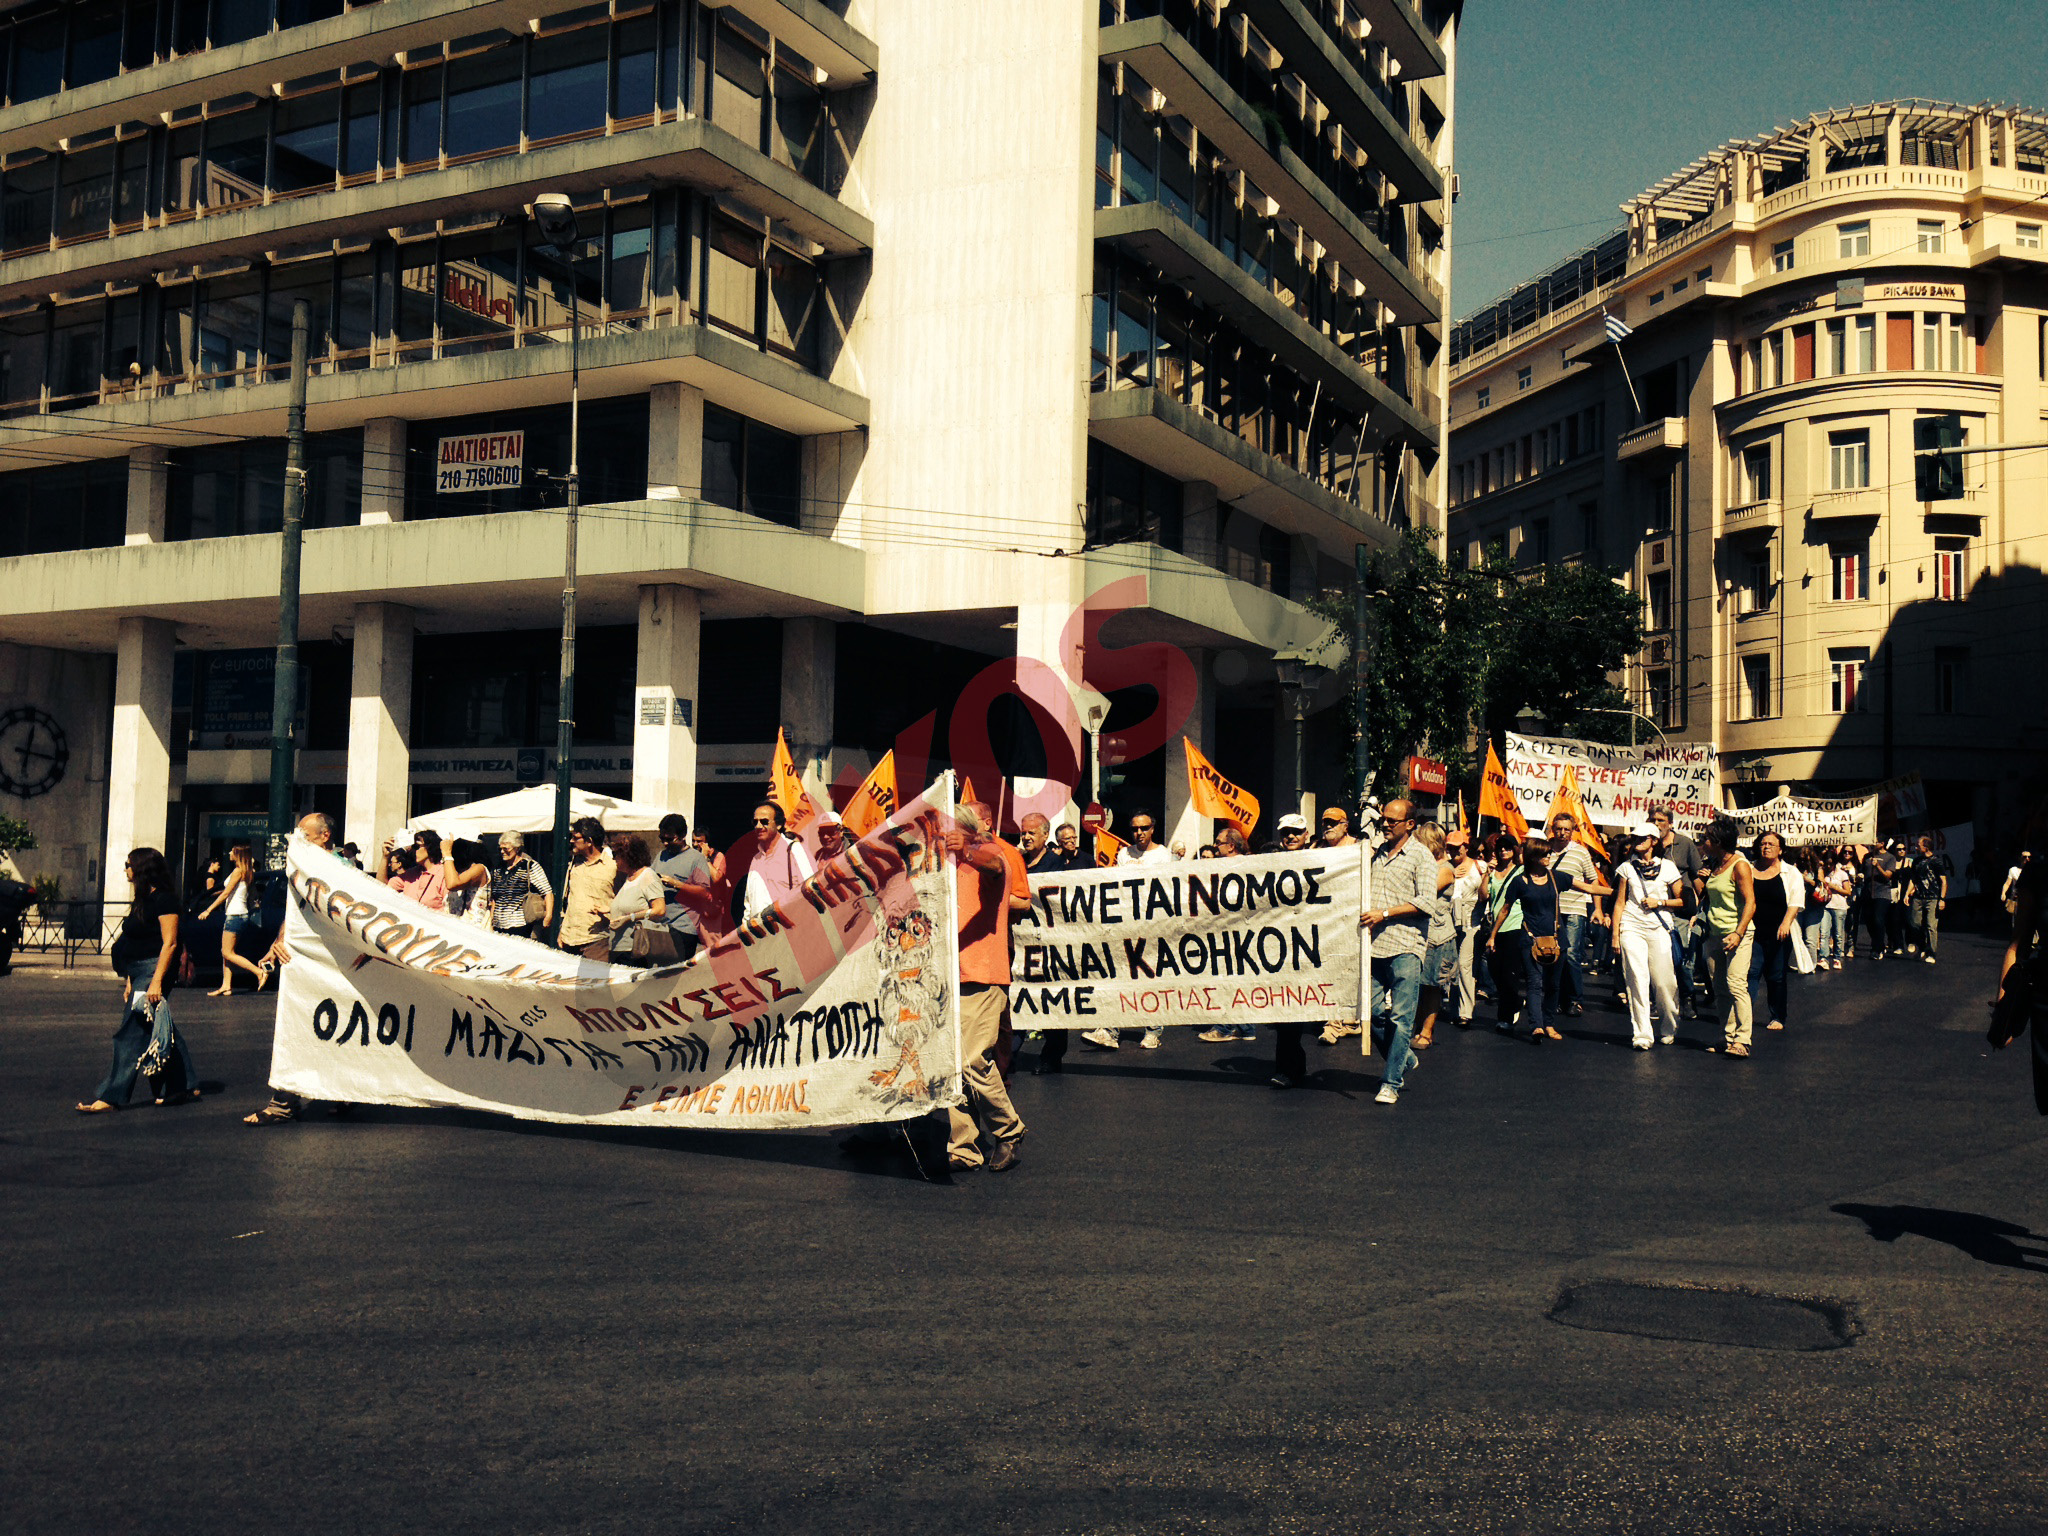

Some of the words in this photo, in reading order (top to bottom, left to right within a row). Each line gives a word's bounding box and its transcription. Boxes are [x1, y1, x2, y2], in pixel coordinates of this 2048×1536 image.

[1930, 286, 1956, 297] BANK
[441, 435, 521, 464] ΔΙΑΤΙΘΕΤΑΙ
[440, 470, 461, 489] 210
[466, 465, 520, 488] 7760600
[225, 654, 276, 672] euroch
[1532, 741, 1579, 758] ΕΙΣΤΕ
[1586, 745, 1636, 764] ΠΑΝΤΑ
[409, 760, 449, 772] ΘΝΙΚΗ
[451, 760, 513, 772] ΤΡΑΠΕΖΑ
[547, 759, 616, 771] NIONAL
[1421, 768, 1444, 785] vodafone
[1627, 764, 1657, 777] ΑΥΤΟ
[1663, 767, 1688, 781] ΠΟΥ
[1692, 768, 1715, 787] ΔΕΝ
[1581, 788, 1602, 808] ΝΑ
[1773, 802, 1787, 810] ΓΙΑ
[1807, 799, 1864, 811] ΣΧΟΛΕΙΟ
[225, 818, 269, 828] eurochang
[1732, 811, 1821, 825] ΙΚΑΙΟΥΜΑΣΤΕ
[1833, 814, 1852, 822] ΚΑΙ
[1038, 876, 1183, 928] ΓΙΝΕΤΑΙ
[1187, 866, 1332, 917] ΝΟΜΟΣ
[1024, 941, 1117, 982] ΕΙΝΑΙ
[1124, 924, 1321, 980] ΚΑΘΗΚΟΝ
[564, 966, 804, 1034] ΑΠΟΛΥΣΕΙΣ
[1013, 986, 1097, 1015] ΛΜΕ
[1119, 987, 1222, 1013] ΝΟΤΙΑΣ
[1231, 983, 1337, 1009] ΑΘΗΝΑΣ
[313, 997, 416, 1053] ΟΛΟΙ
[543, 1036, 624, 1071] ΓΙΑ
[622, 1032, 710, 1073] ΤΗΝ
[724, 998, 884, 1071] ΑΝΑΤΡΟΠΗ
[652, 1083, 726, 1115] ΕΛΜΕ
[729, 1078, 811, 1115] ΑΘΗΝΑΣ
